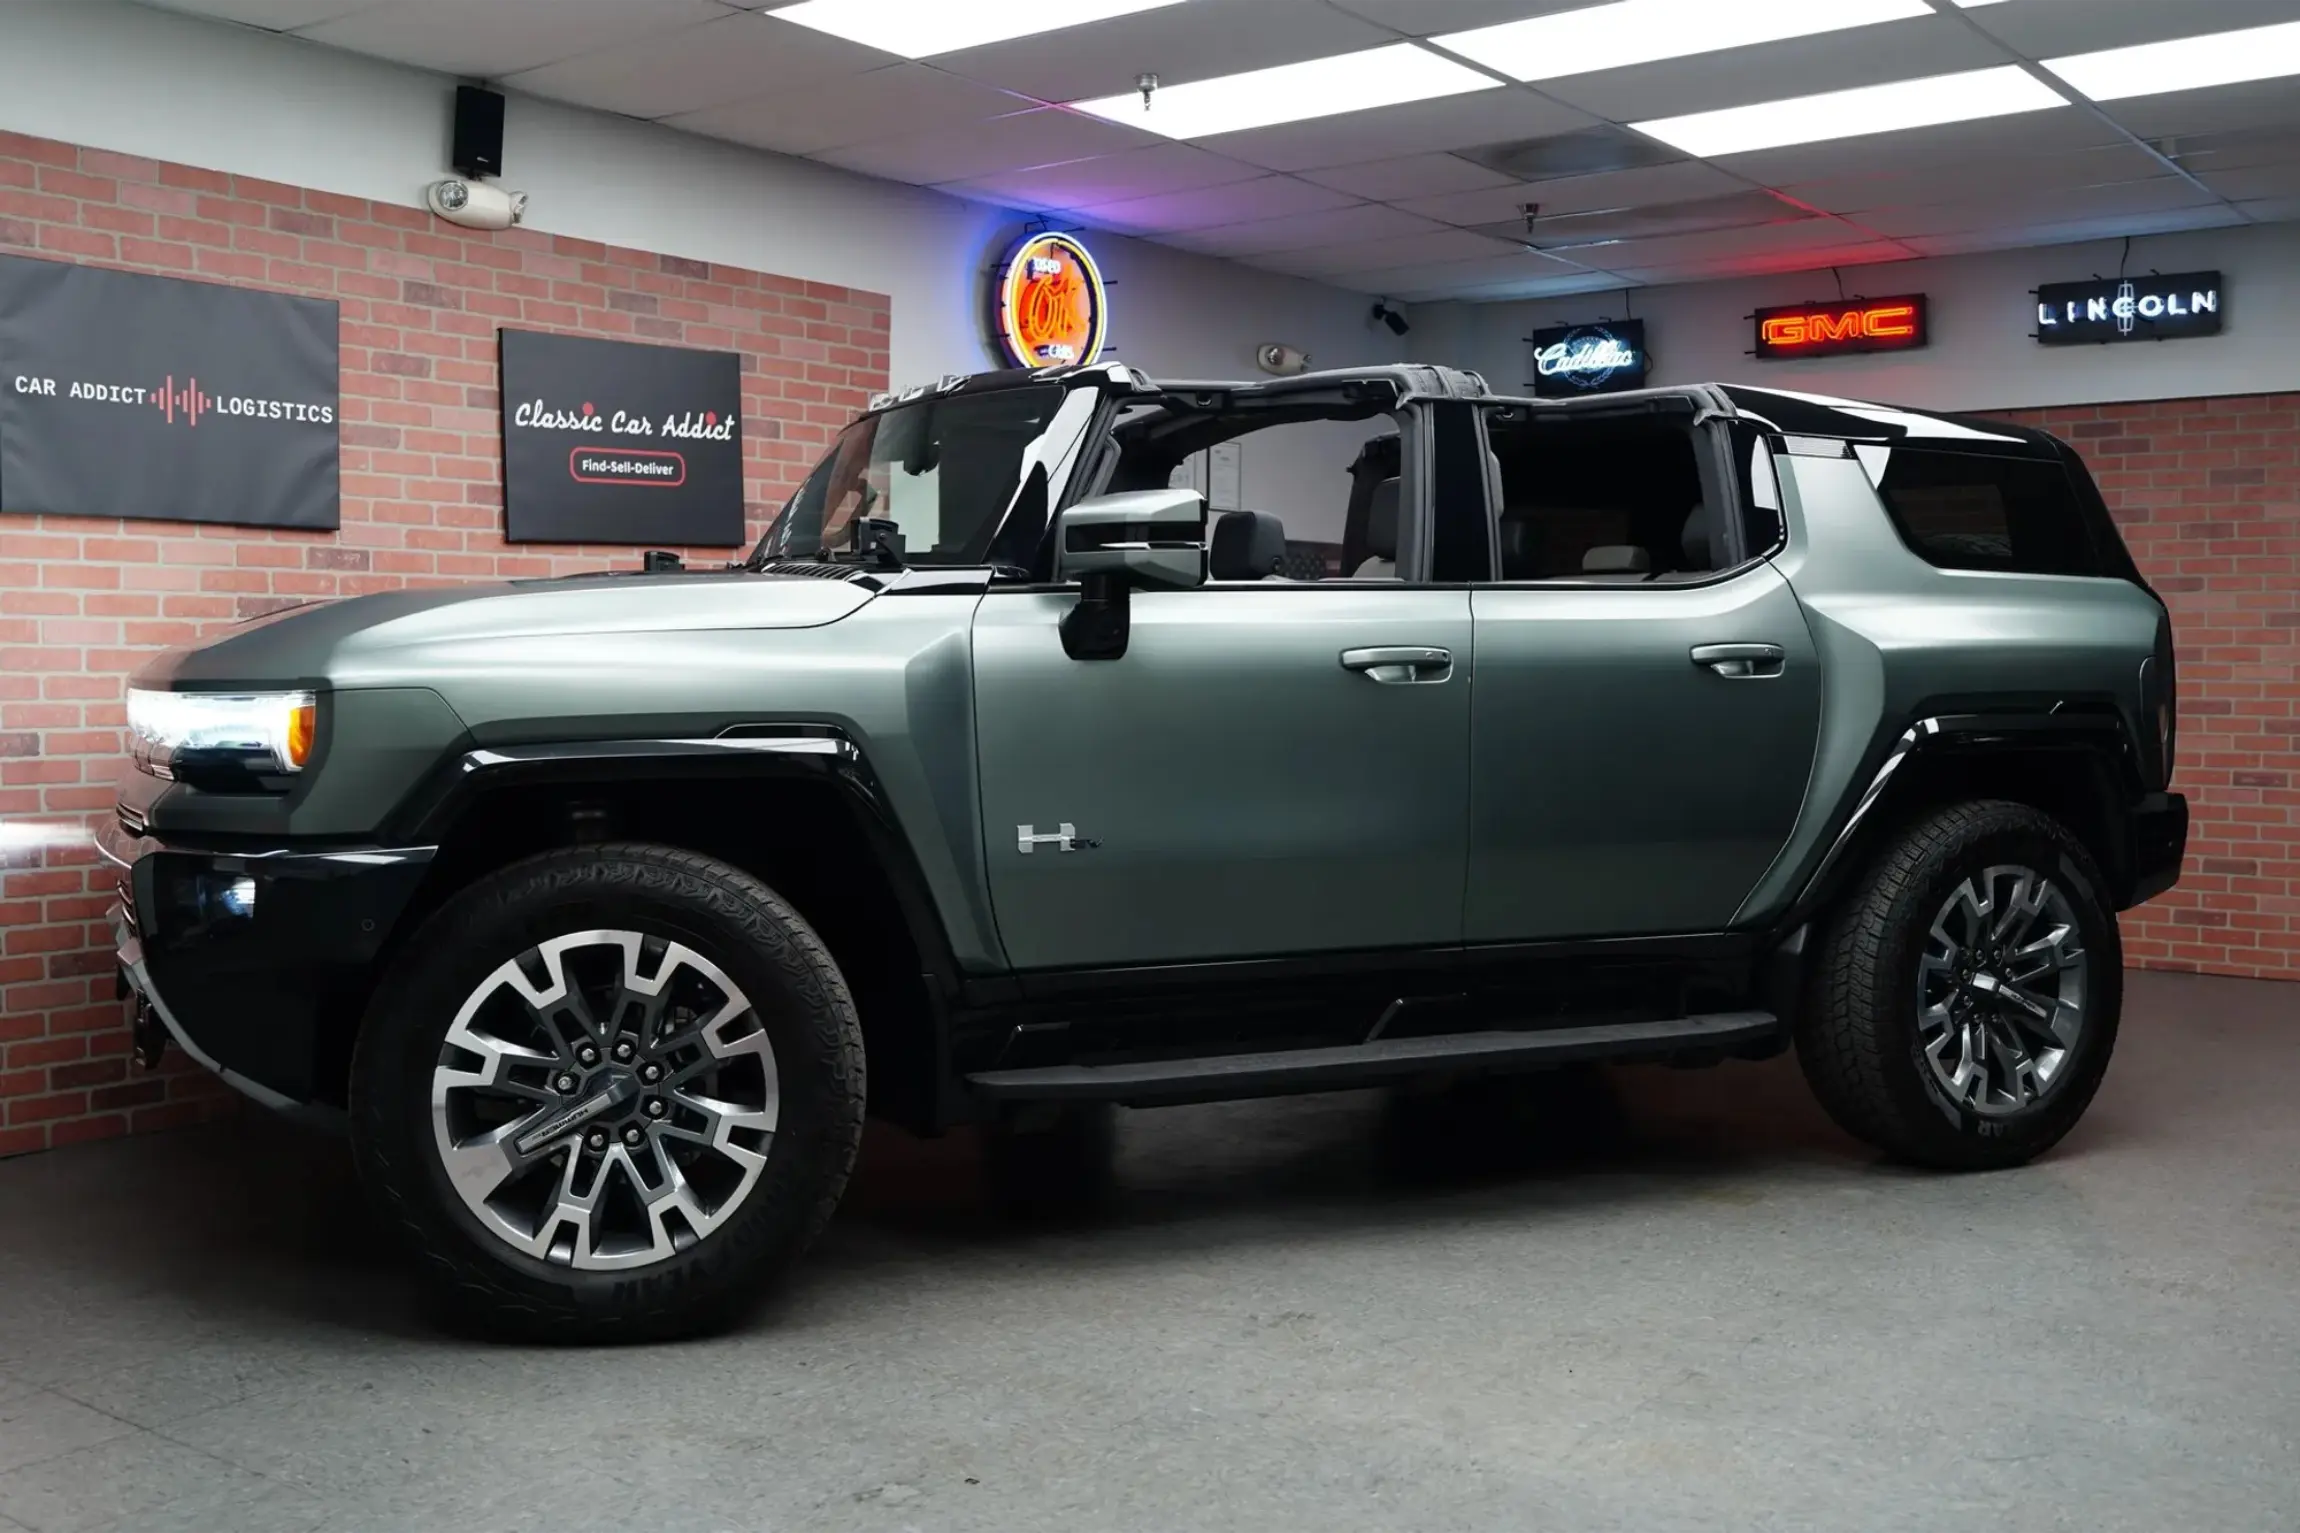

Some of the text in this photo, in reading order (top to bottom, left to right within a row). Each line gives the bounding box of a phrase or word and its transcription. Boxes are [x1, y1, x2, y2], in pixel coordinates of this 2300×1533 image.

[1762, 306, 1914, 345] GMC
[2038, 290, 2217, 325] LINCOLN
[1533, 339, 1633, 376] Cadillac
[14, 375, 333, 424] CAR ADDICT LOGISTICS
[514, 398, 735, 441] Classic Car Addict
[582, 458, 674, 476] Find-Sell-Deliver
